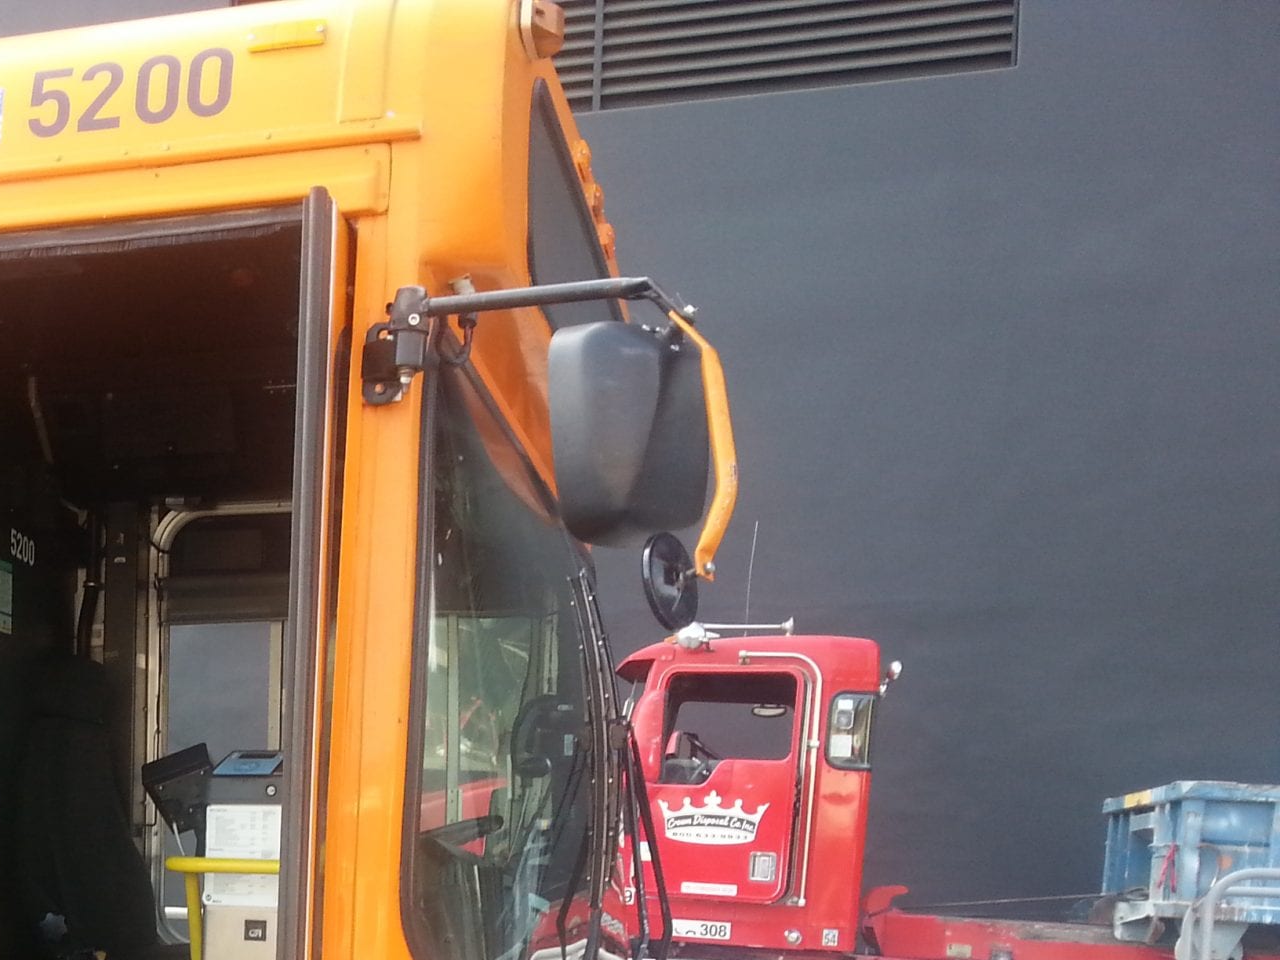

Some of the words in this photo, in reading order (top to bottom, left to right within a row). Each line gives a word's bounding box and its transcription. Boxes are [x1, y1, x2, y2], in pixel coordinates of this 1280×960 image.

[28, 47, 235, 139] 5200
[10, 528, 35, 566] 5200
[700, 923, 728, 938] 308
